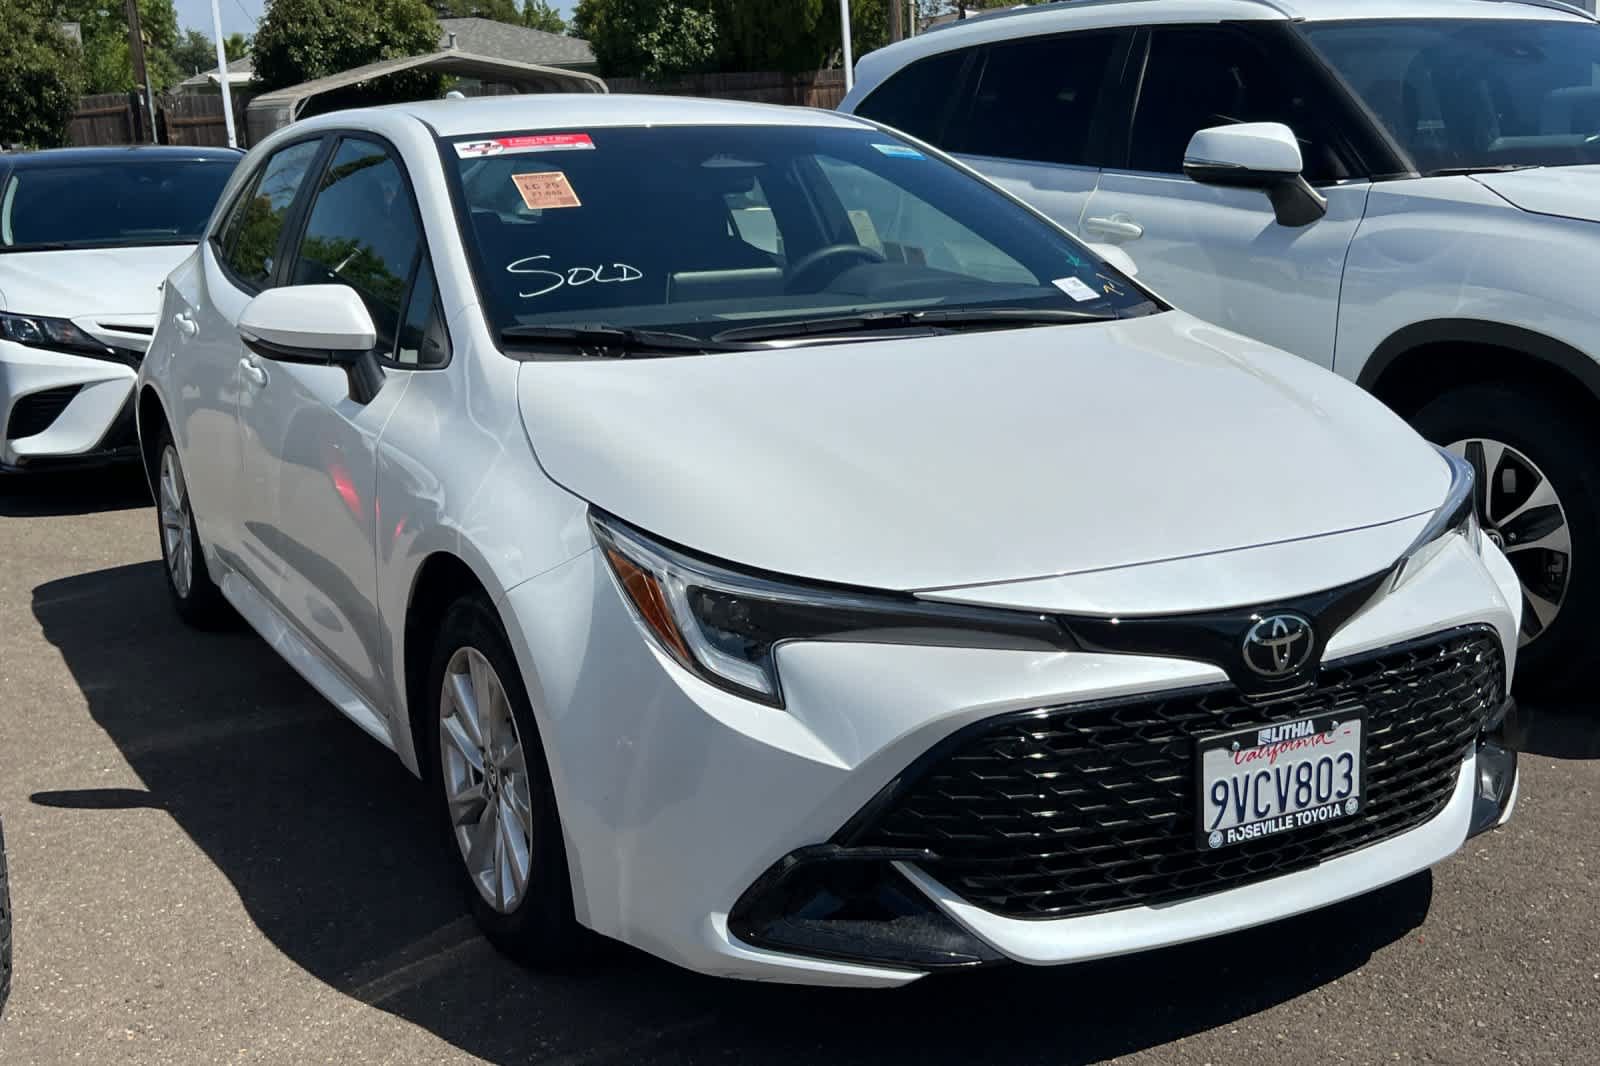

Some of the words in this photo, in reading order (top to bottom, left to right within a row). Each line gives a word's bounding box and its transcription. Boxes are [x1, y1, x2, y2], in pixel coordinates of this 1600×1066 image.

[507, 255, 643, 298] SOLD
[1271, 720, 1315, 743] LITHIA
[1211, 752, 1354, 829] 9VCV803
